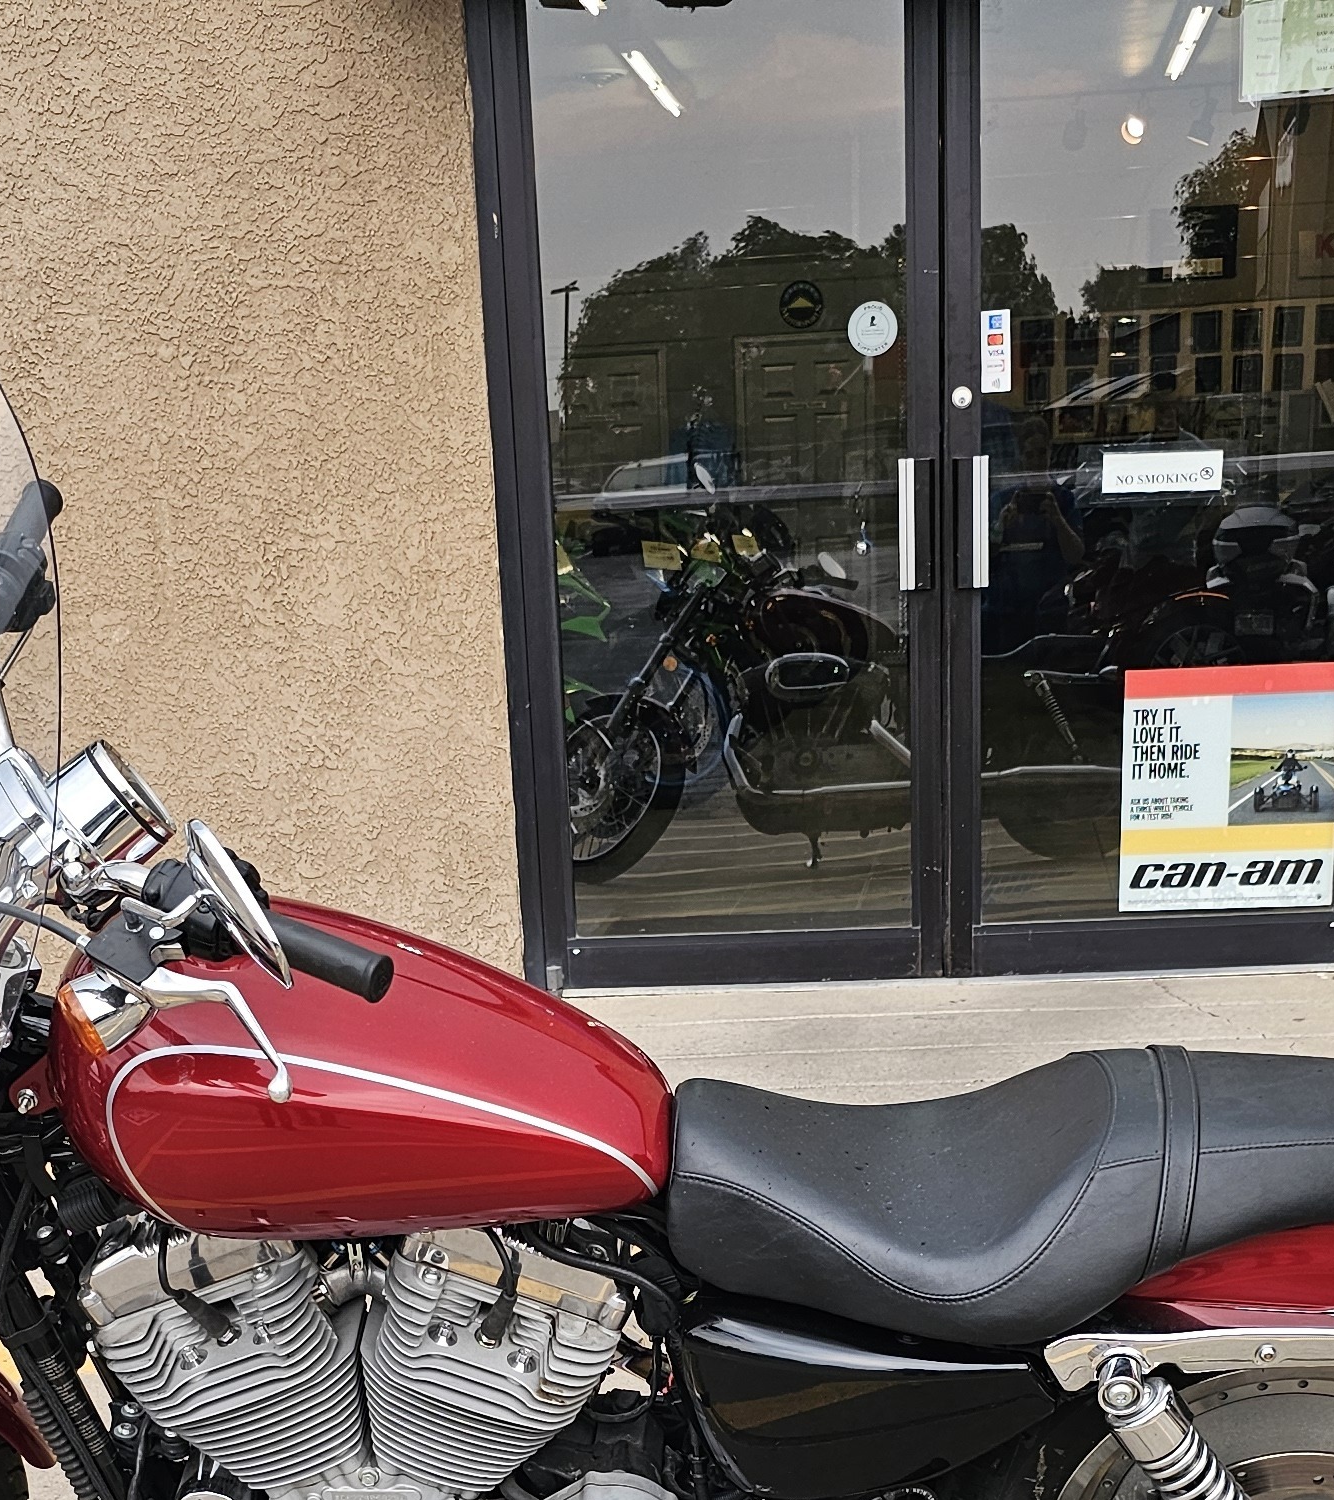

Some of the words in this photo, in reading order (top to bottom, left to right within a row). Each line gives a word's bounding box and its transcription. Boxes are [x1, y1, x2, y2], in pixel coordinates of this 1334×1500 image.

[1116, 475, 1134, 486] NO
[1137, 473, 1198, 485] SMOKING
[1133, 708, 1158, 726] TRY
[1163, 708, 1178, 725] IT.
[1133, 727, 1165, 744] LOVE
[1169, 726, 1184, 743] IT.
[1132, 745, 1166, 762] THEN
[1171, 743, 1201, 761] RIDE
[1132, 763, 1144, 780] IT
[1148, 762, 1190, 779] HOME.
[1151, 797, 1168, 805] ABOUT
[1129, 859, 1323, 889] can-am
